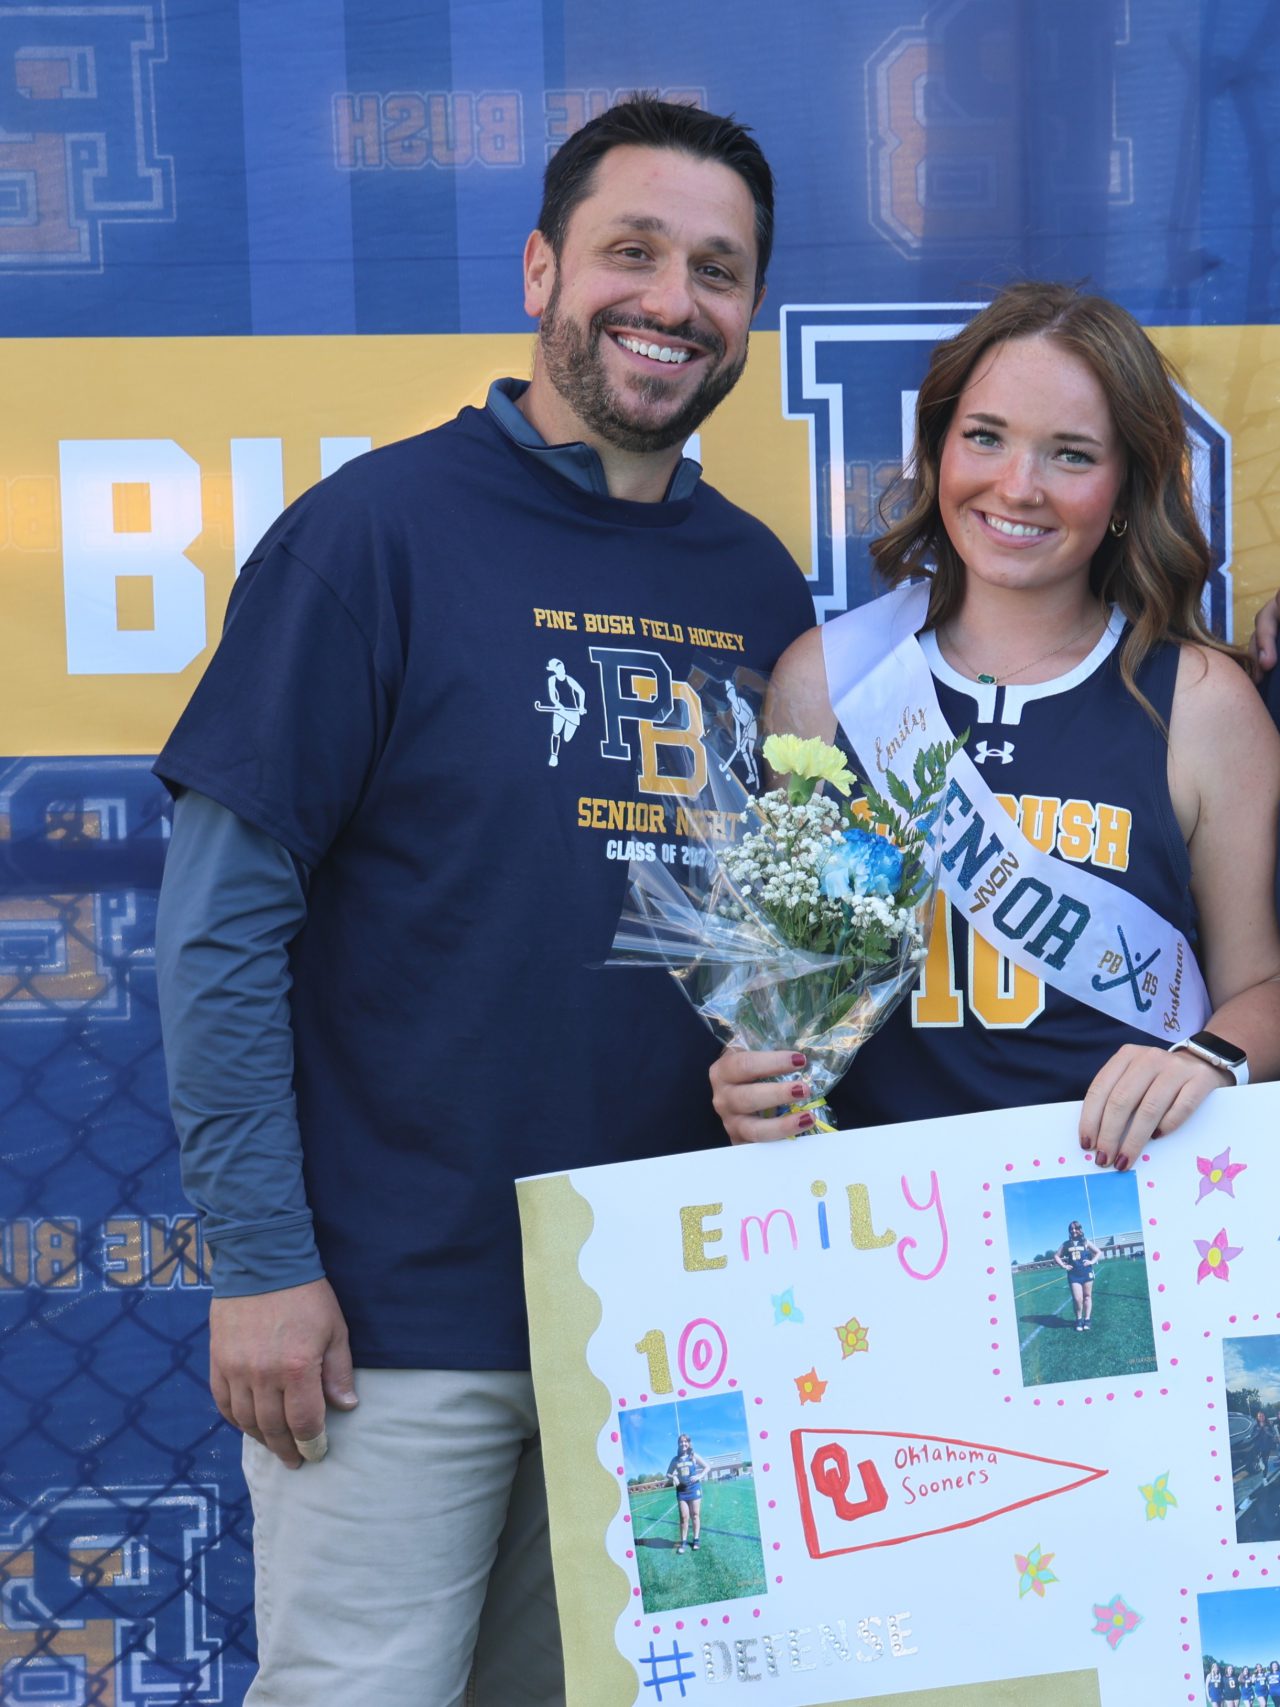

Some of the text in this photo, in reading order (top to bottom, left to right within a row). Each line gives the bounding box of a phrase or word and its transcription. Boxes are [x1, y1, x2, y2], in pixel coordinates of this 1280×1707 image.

[533, 607, 745, 651] PINE BUSH FIELD HOCKEY
[588, 646, 708, 797] PB
[875, 705, 928, 773] Emily
[577, 796, 667, 834] SENIOR
[606, 839, 656, 862] CLASS
[661, 843, 677, 864] OF
[1097, 949, 1123, 975] PB
[1141, 971, 1159, 996] HS
[1163, 940, 1184, 1033] Bushman
[635, 1317, 728, 1395] 10
[810, 1442, 889, 1521] OU
[901, 1469, 989, 1505] Sooners
